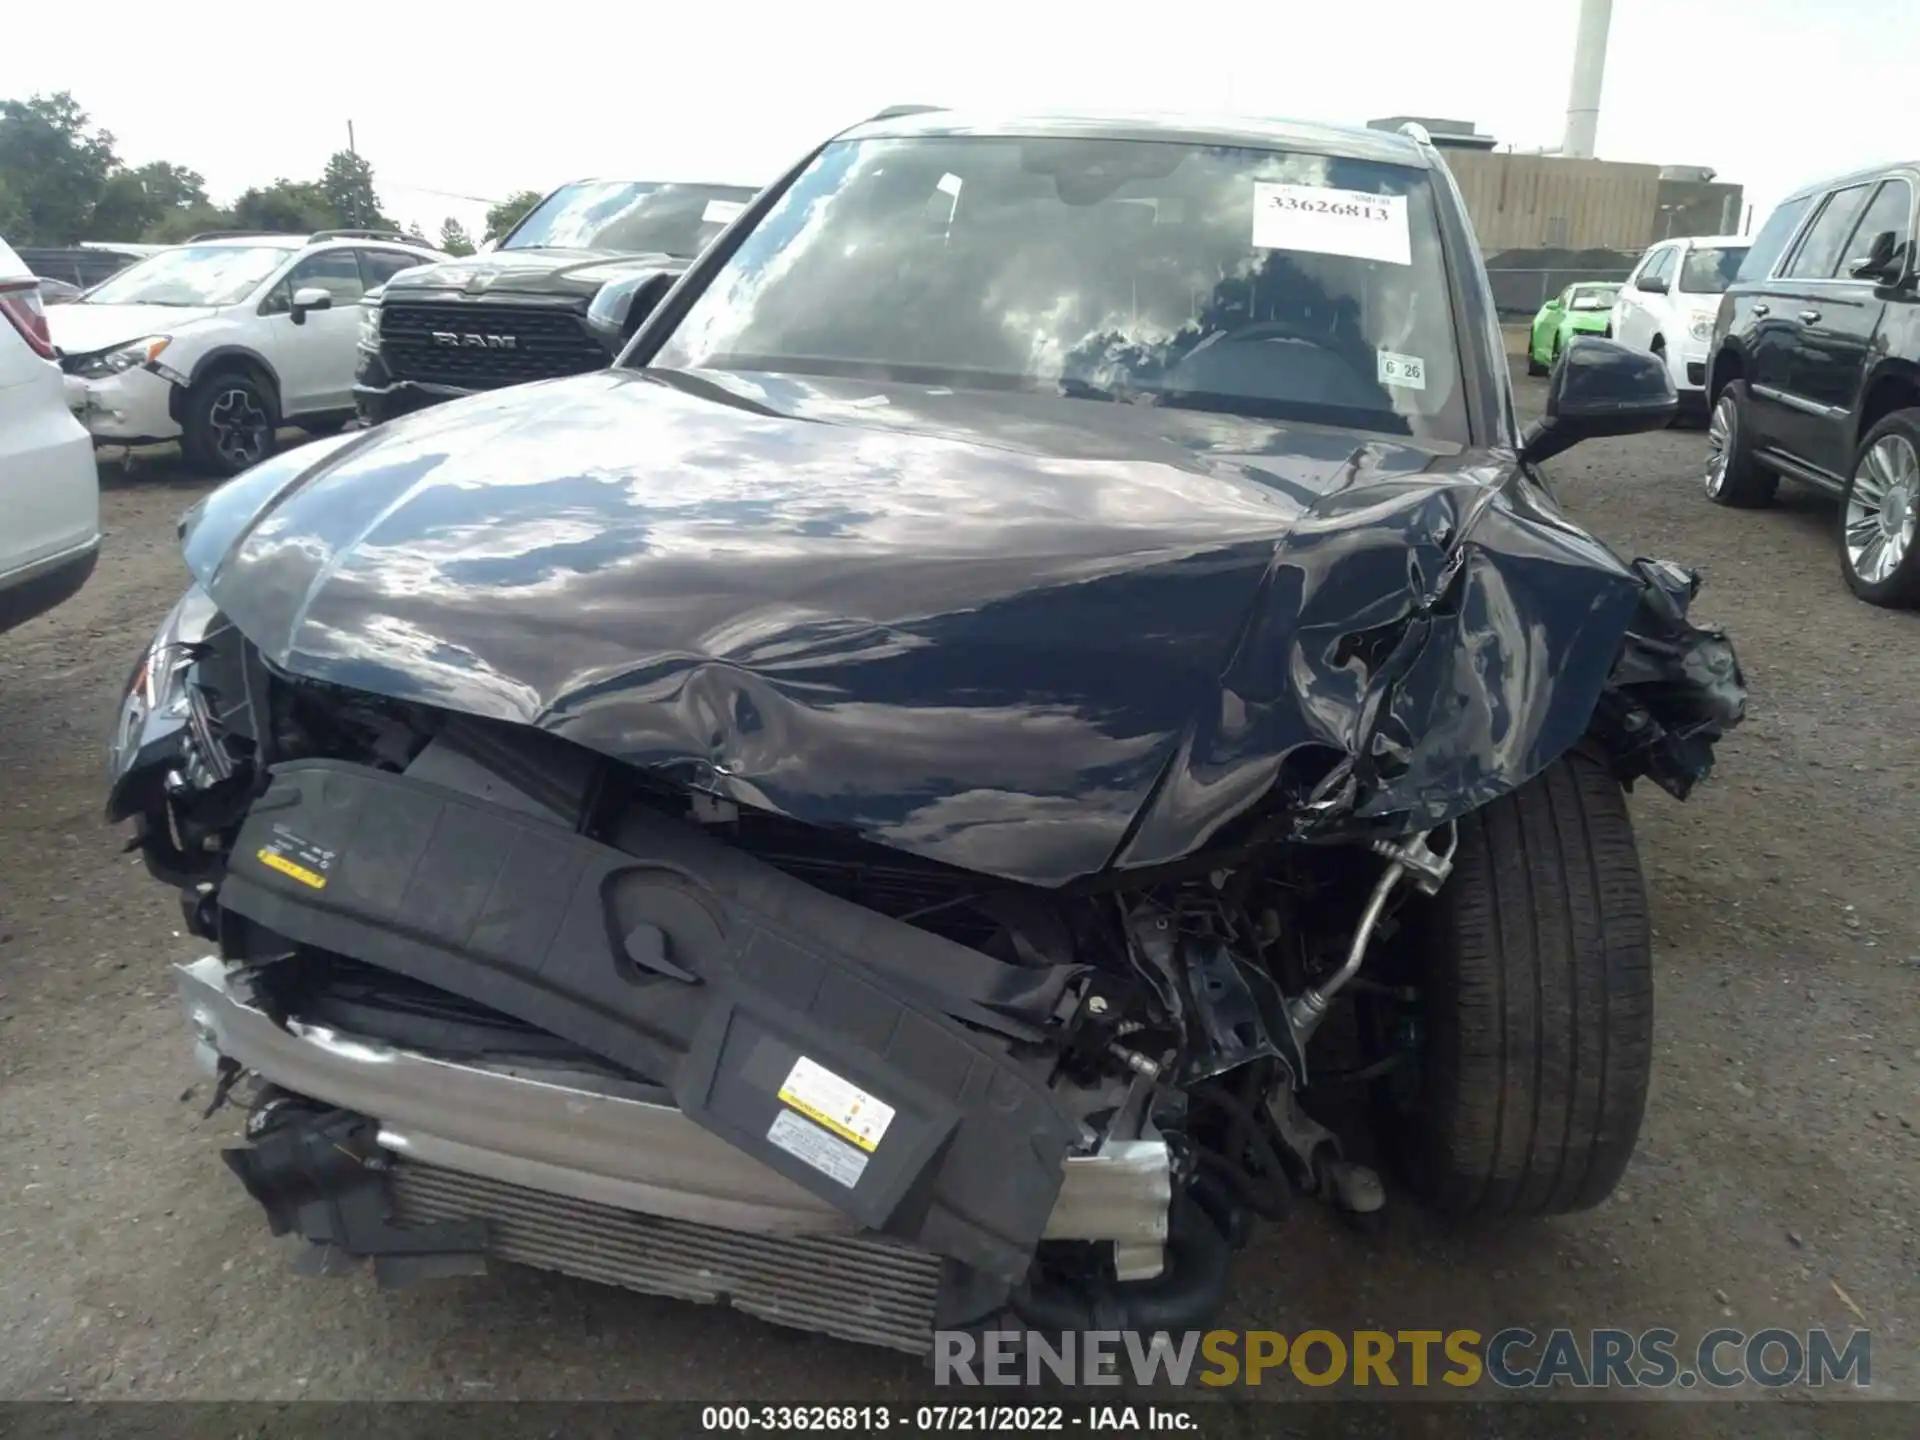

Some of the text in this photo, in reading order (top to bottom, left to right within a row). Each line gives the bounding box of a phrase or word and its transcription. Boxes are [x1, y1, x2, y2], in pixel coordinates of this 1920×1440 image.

[1268, 196, 1390, 222] 33626813
[432, 331, 518, 349] RAM
[1385, 360, 1422, 380] 6 26
